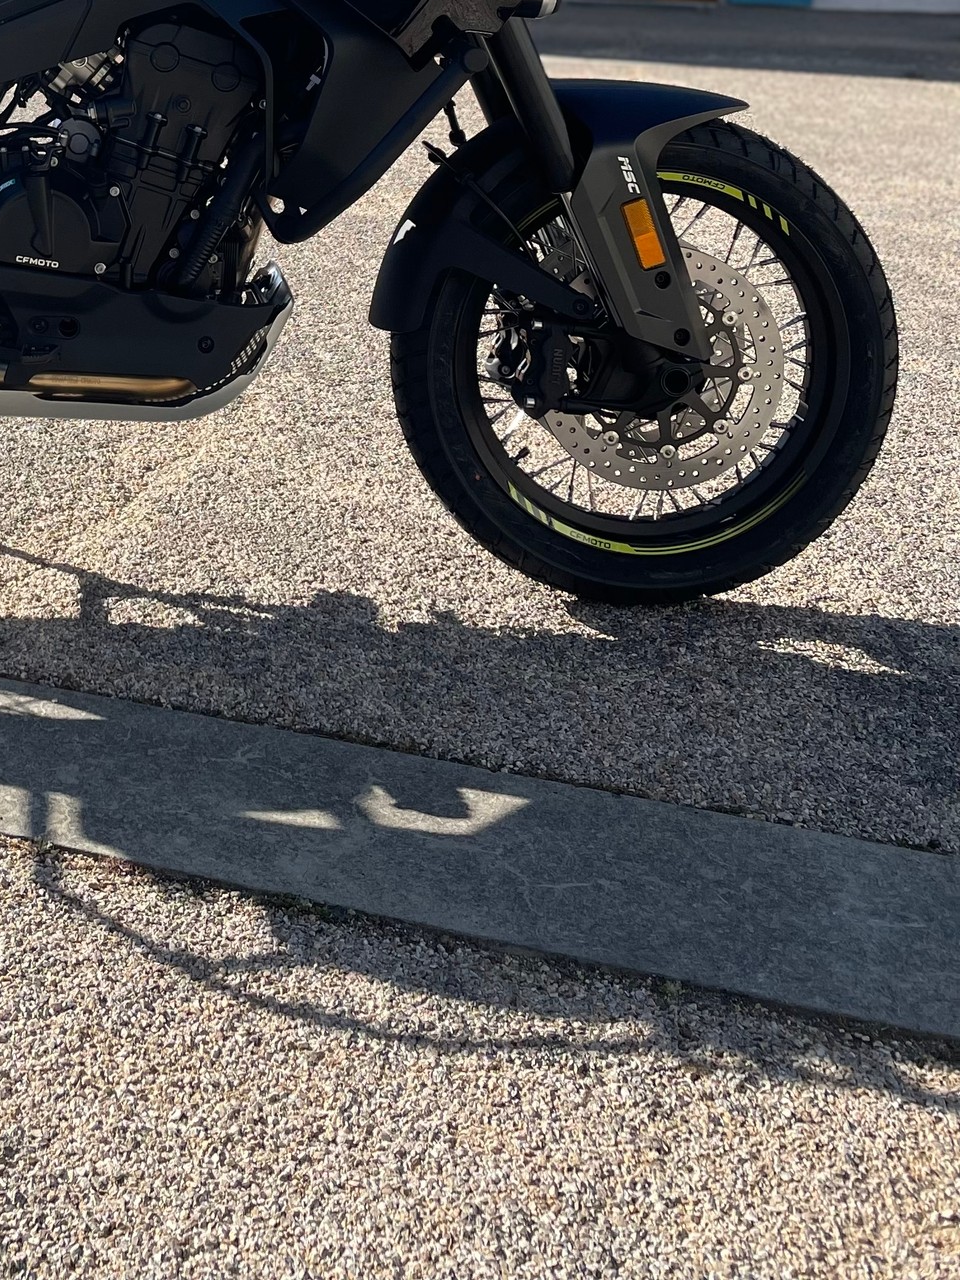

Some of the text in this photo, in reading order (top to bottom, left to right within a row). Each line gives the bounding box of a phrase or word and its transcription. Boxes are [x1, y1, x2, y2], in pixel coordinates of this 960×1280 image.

[617, 156, 640, 194] MSC
[682, 174, 726, 190] CFMOTO
[15, 255, 59, 268] CFMOTO
[569, 530, 611, 549] CFMOTO
